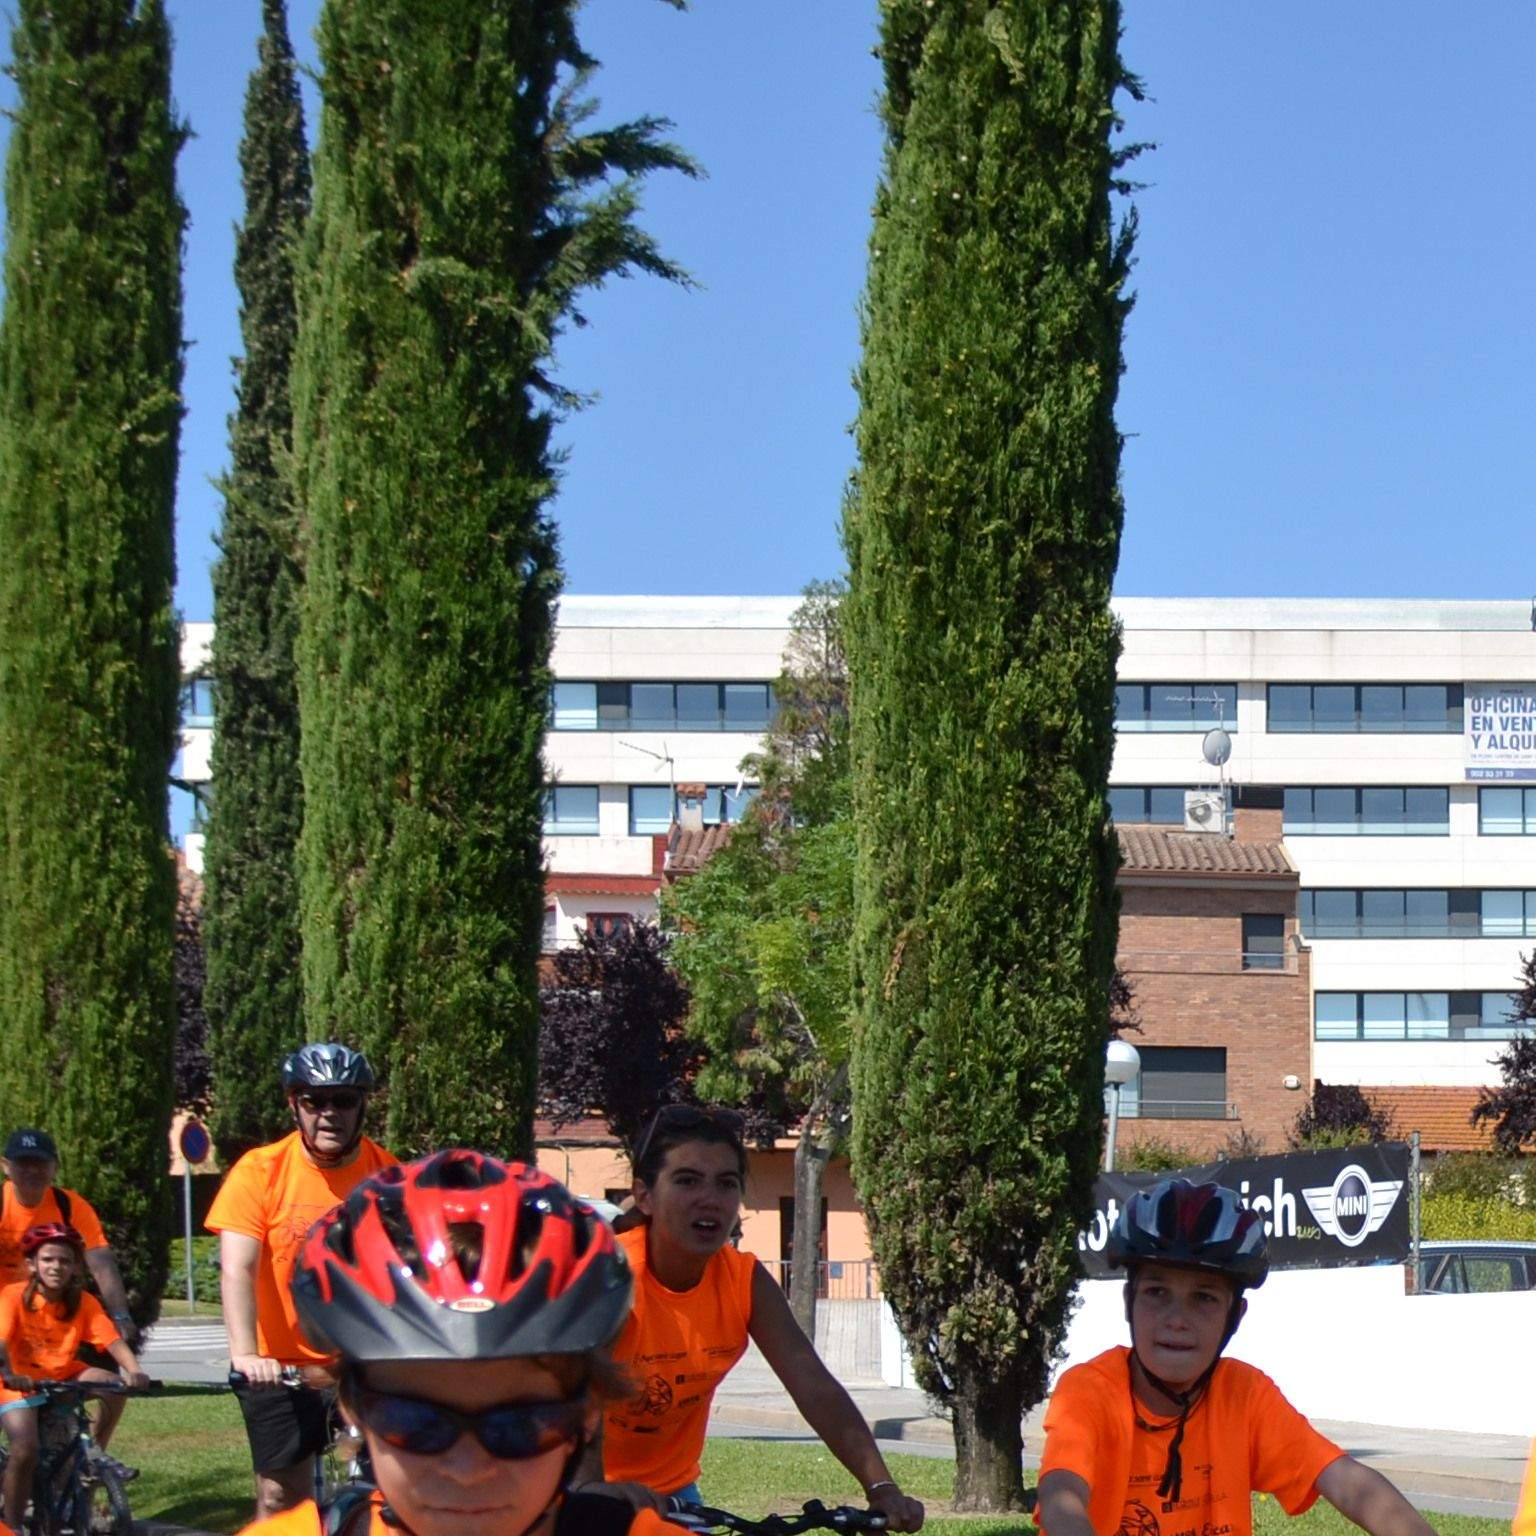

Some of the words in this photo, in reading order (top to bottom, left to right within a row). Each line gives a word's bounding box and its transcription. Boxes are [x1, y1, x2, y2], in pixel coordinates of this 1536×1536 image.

[1471, 716, 1496, 732] EN
[1471, 734, 1482, 750] Y
[1336, 1195, 1367, 1217] MINI
